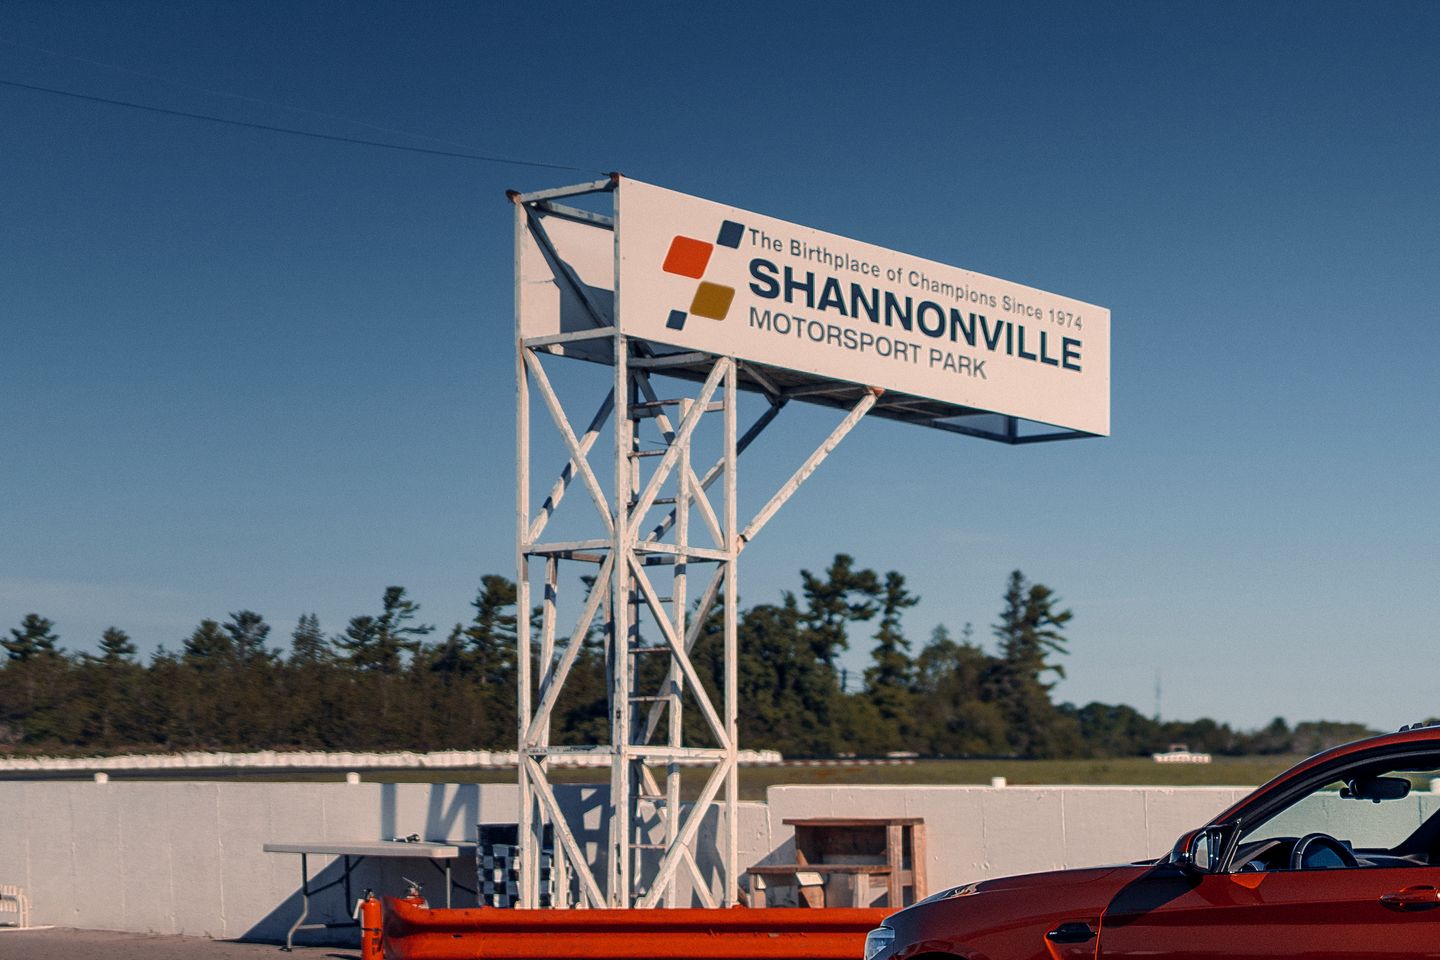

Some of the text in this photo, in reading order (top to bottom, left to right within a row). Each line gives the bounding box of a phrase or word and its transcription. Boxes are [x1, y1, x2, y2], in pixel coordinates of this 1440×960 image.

[748, 257, 1082, 372] SHANNONVILLE
[749, 228, 1083, 331] The Birthplace of Champions Since 1974
[749, 306, 988, 380] MOTORSPORT PARK
